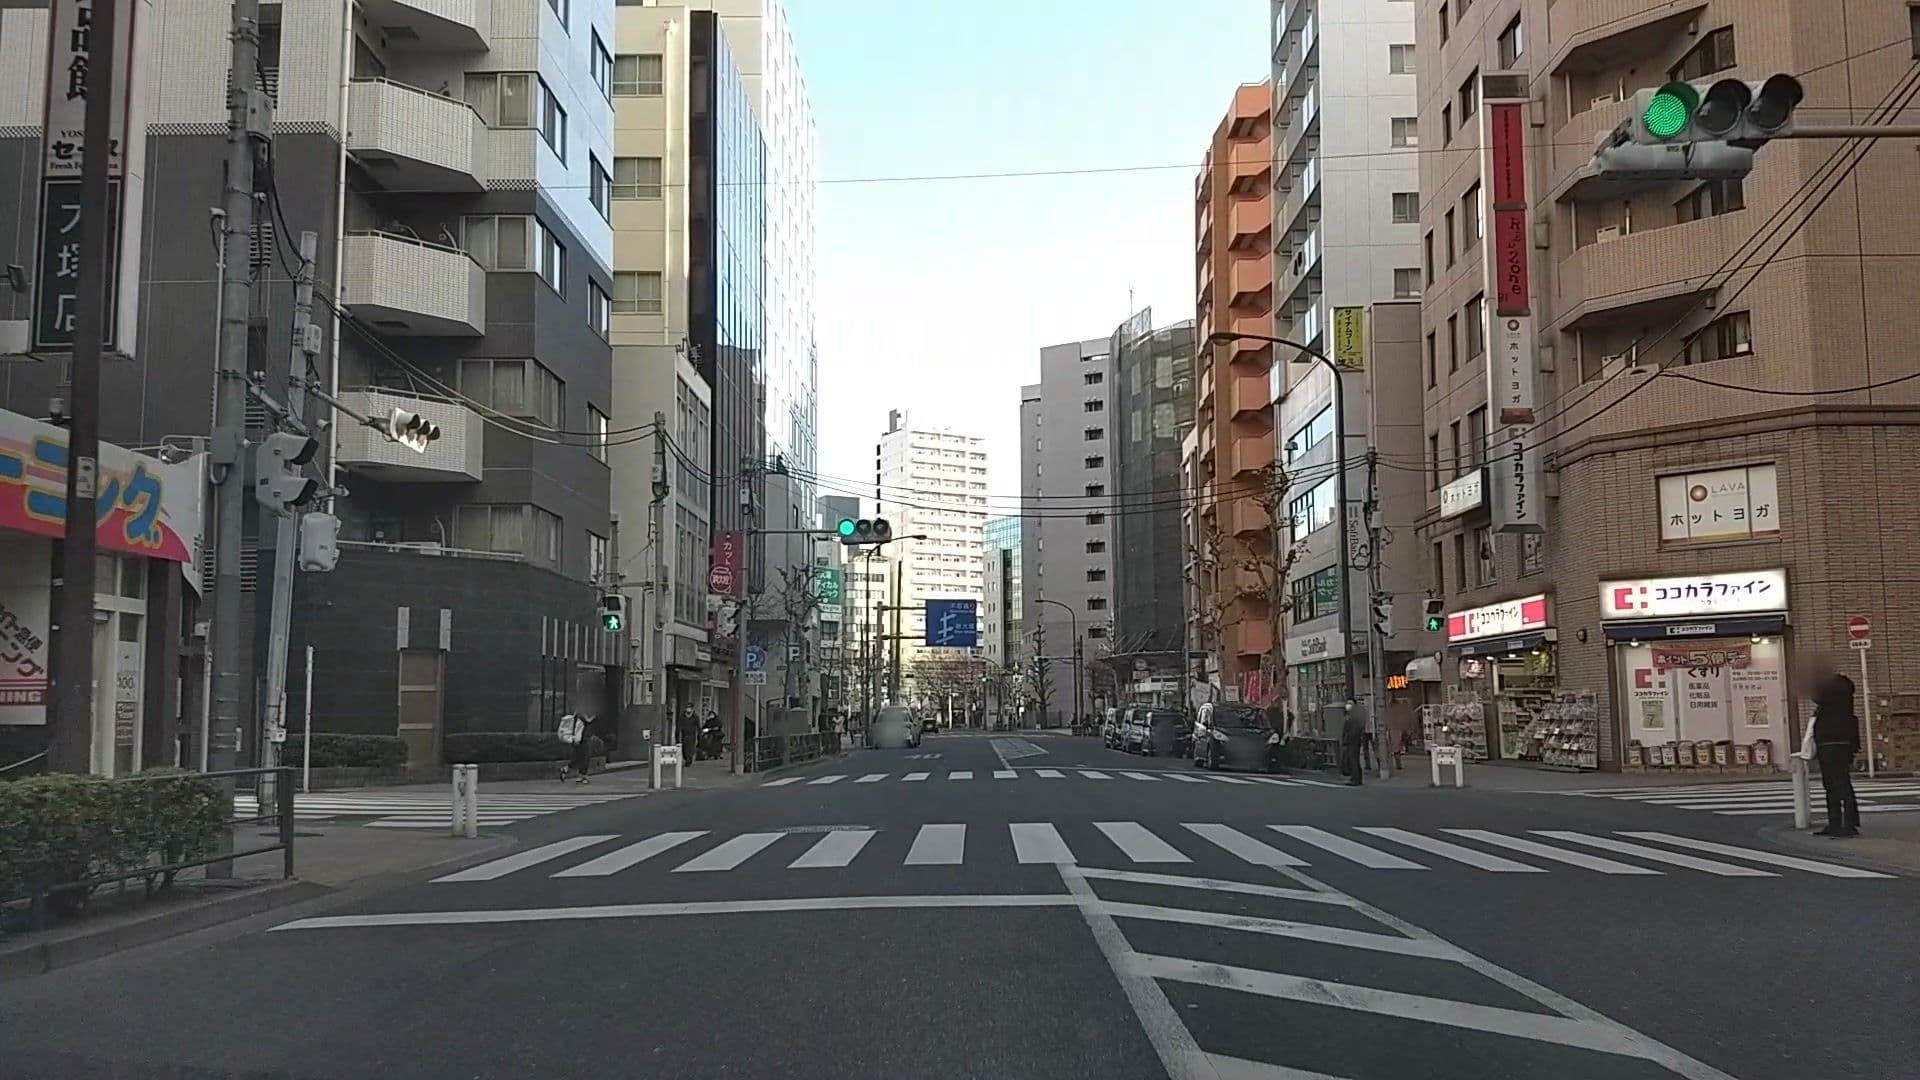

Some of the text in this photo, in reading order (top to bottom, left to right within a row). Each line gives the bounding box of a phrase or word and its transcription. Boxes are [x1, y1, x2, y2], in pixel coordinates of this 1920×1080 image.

[1509, 342, 1521, 403] ホットヨガ
[1513, 442, 1526, 520] ココカラファイン
[1711, 482, 1745, 493] LAVA
[1670, 504, 1770, 526] ホットヨガ
[723, 542, 733, 566] カット
[1655, 580, 1771, 601] ココカラファイン
[746, 652, 758, 668] P
[789, 646, 800, 662] P
[1687, 667, 1720, 678] くすり
